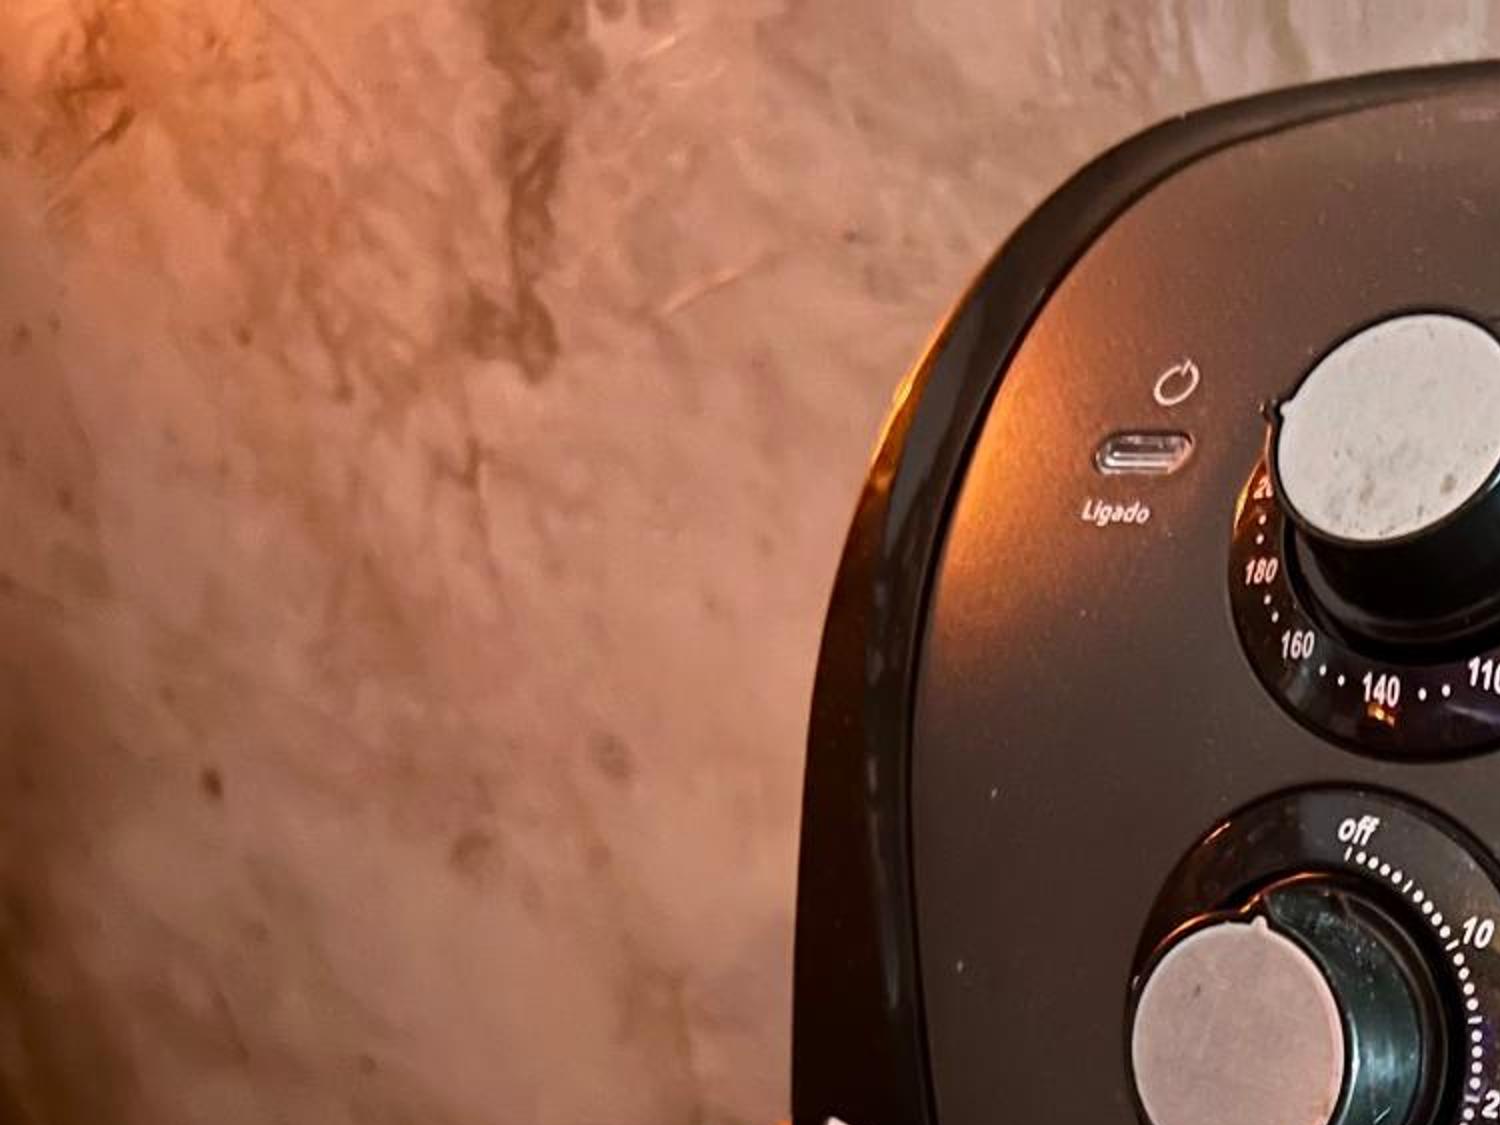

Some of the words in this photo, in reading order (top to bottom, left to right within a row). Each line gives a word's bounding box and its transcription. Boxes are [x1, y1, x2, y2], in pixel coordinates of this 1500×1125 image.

[1081, 499, 1151, 527] Ligado
[1245, 557, 1278, 585] 180
[1281, 630, 1314, 662] 160
[1362, 671, 1400, 708] 140
[1338, 815, 1380, 846] off
[1461, 916, 1495, 949] 10
